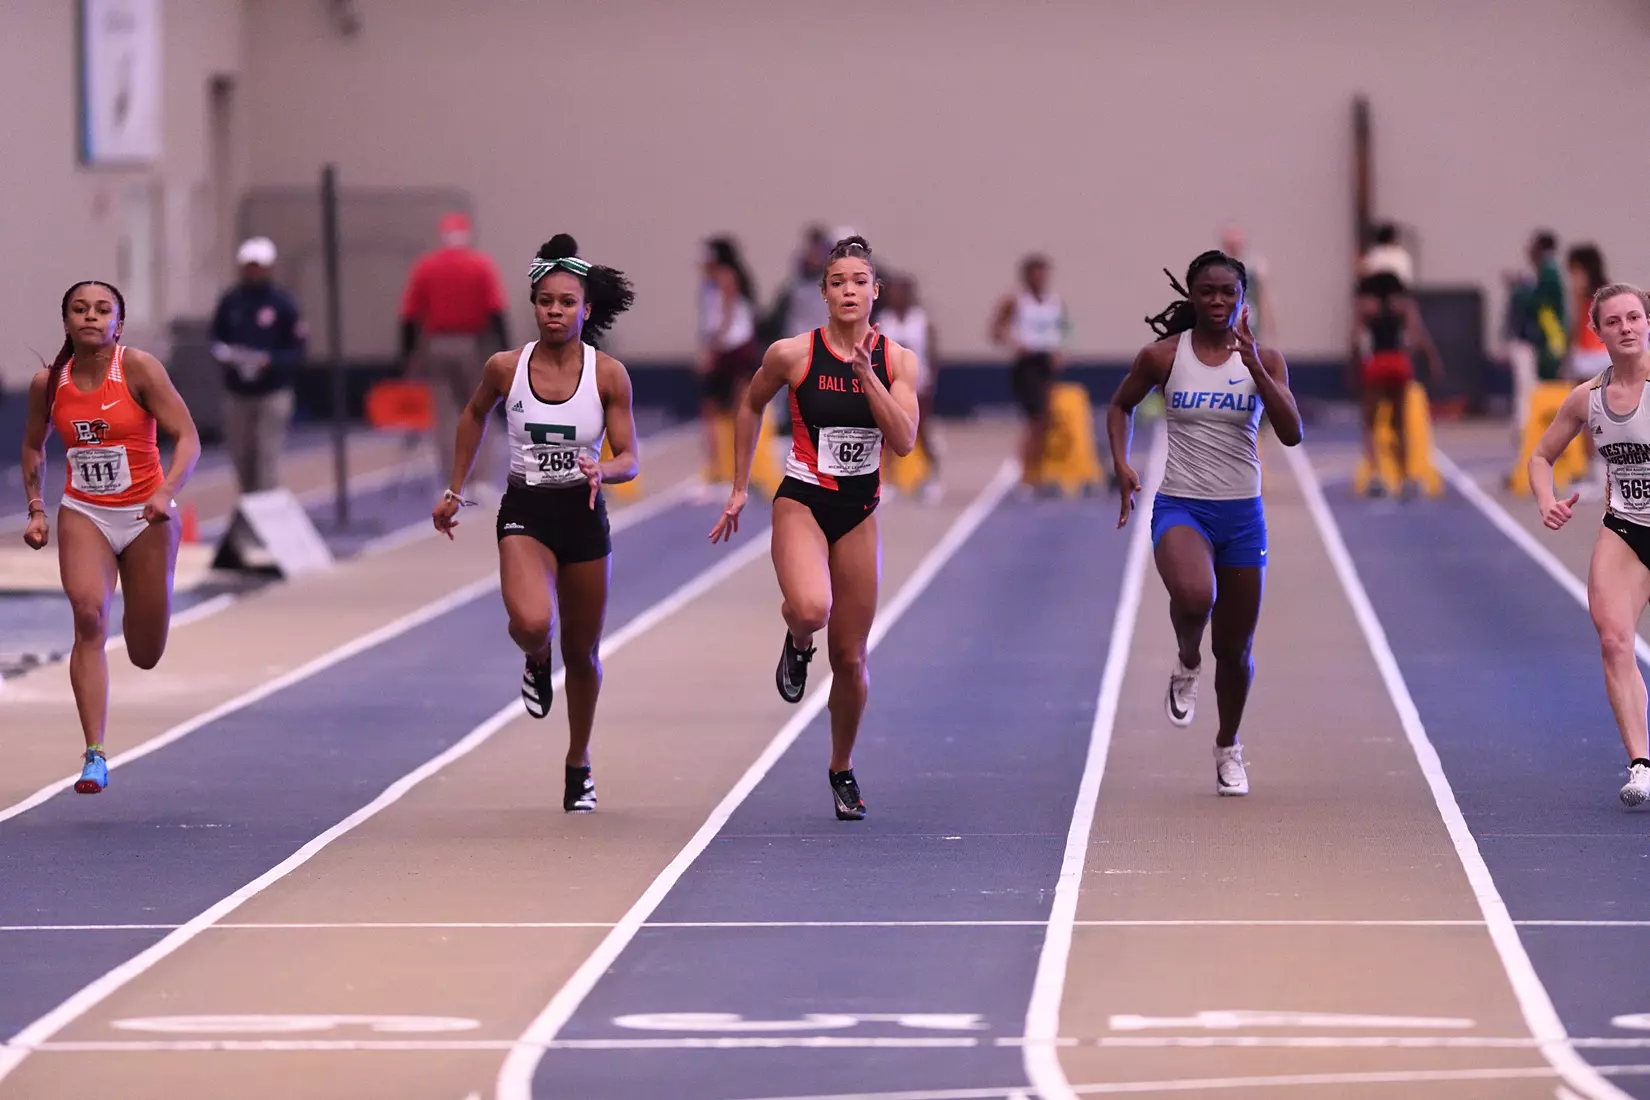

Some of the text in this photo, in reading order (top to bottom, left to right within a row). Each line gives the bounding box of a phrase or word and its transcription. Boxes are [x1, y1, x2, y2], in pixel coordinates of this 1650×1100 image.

[818, 375, 847, 392] BALL
[1171, 391, 1257, 412] BUFFALO
[538, 451, 576, 472] 263
[839, 442, 865, 463] 62
[81, 461, 115, 482] 111
[1620, 479, 1650, 500] 565
